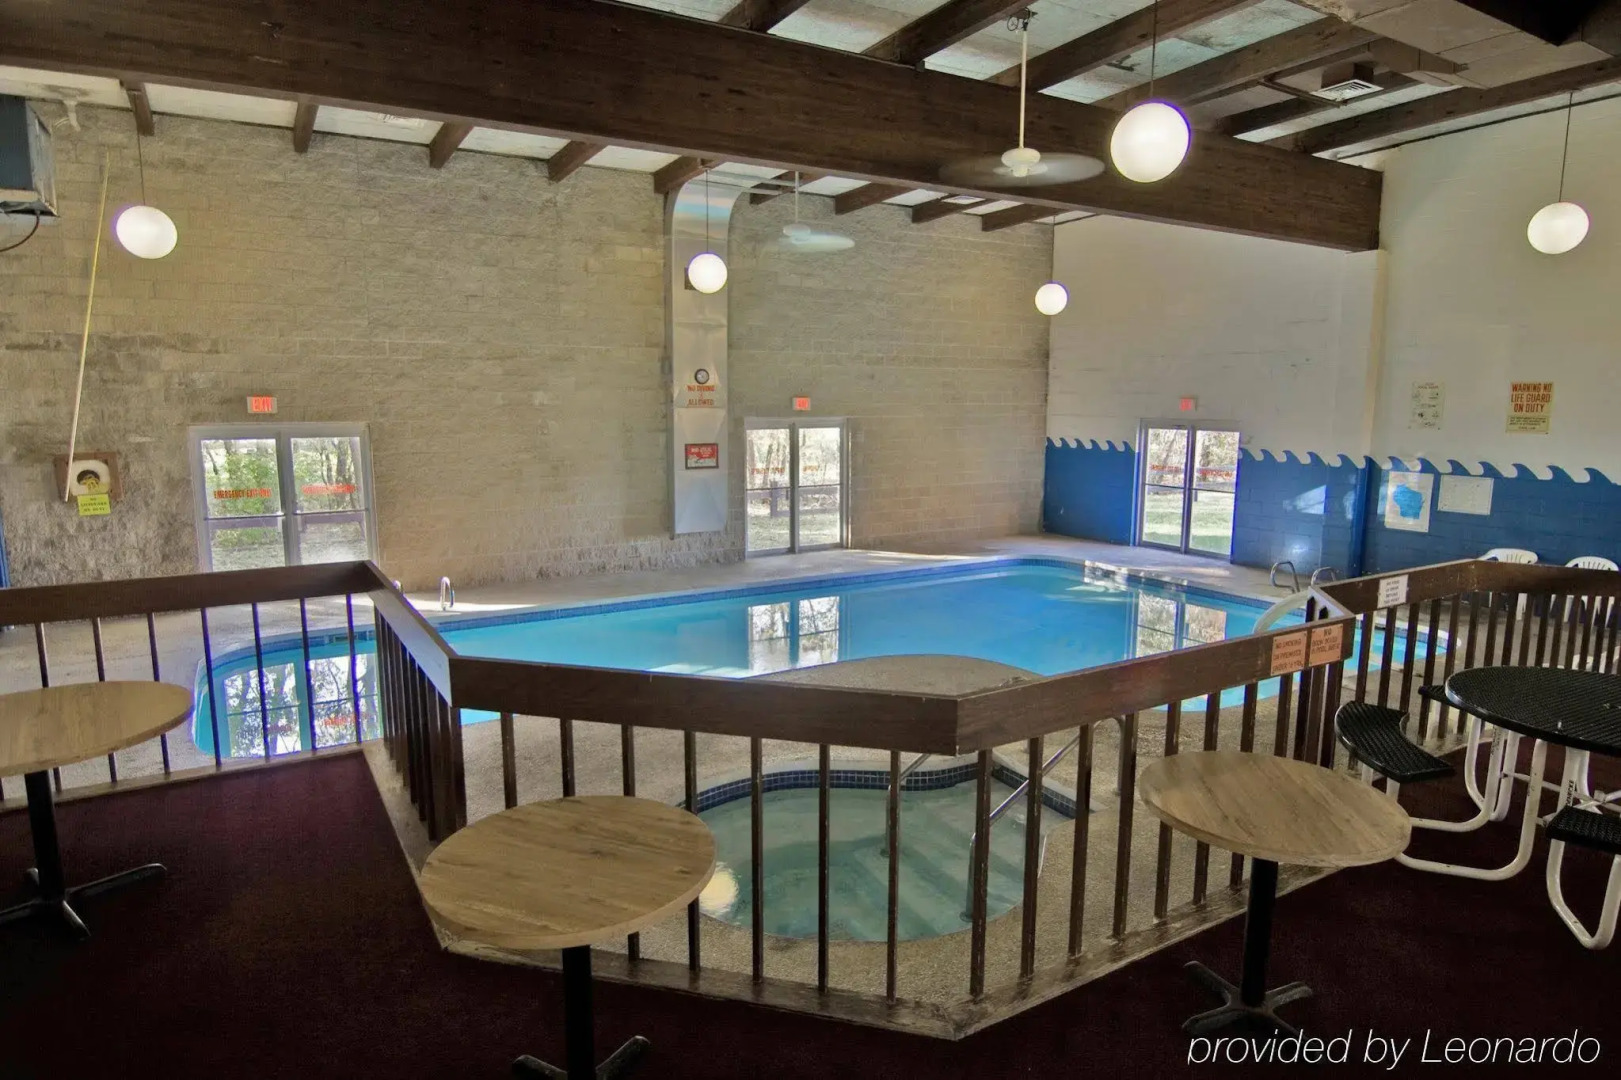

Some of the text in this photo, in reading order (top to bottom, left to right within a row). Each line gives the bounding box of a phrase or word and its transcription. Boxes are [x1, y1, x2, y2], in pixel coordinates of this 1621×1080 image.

[1512, 383, 1553, 393] WARNING NO
[688, 398, 715, 406] ALLOWED
[1511, 393, 1552, 403] LIFE GUARD
[252, 397, 273, 412] EXIT
[1514, 403, 1546, 413] ON DUTY
[1324, 628, 1332, 637] NO
